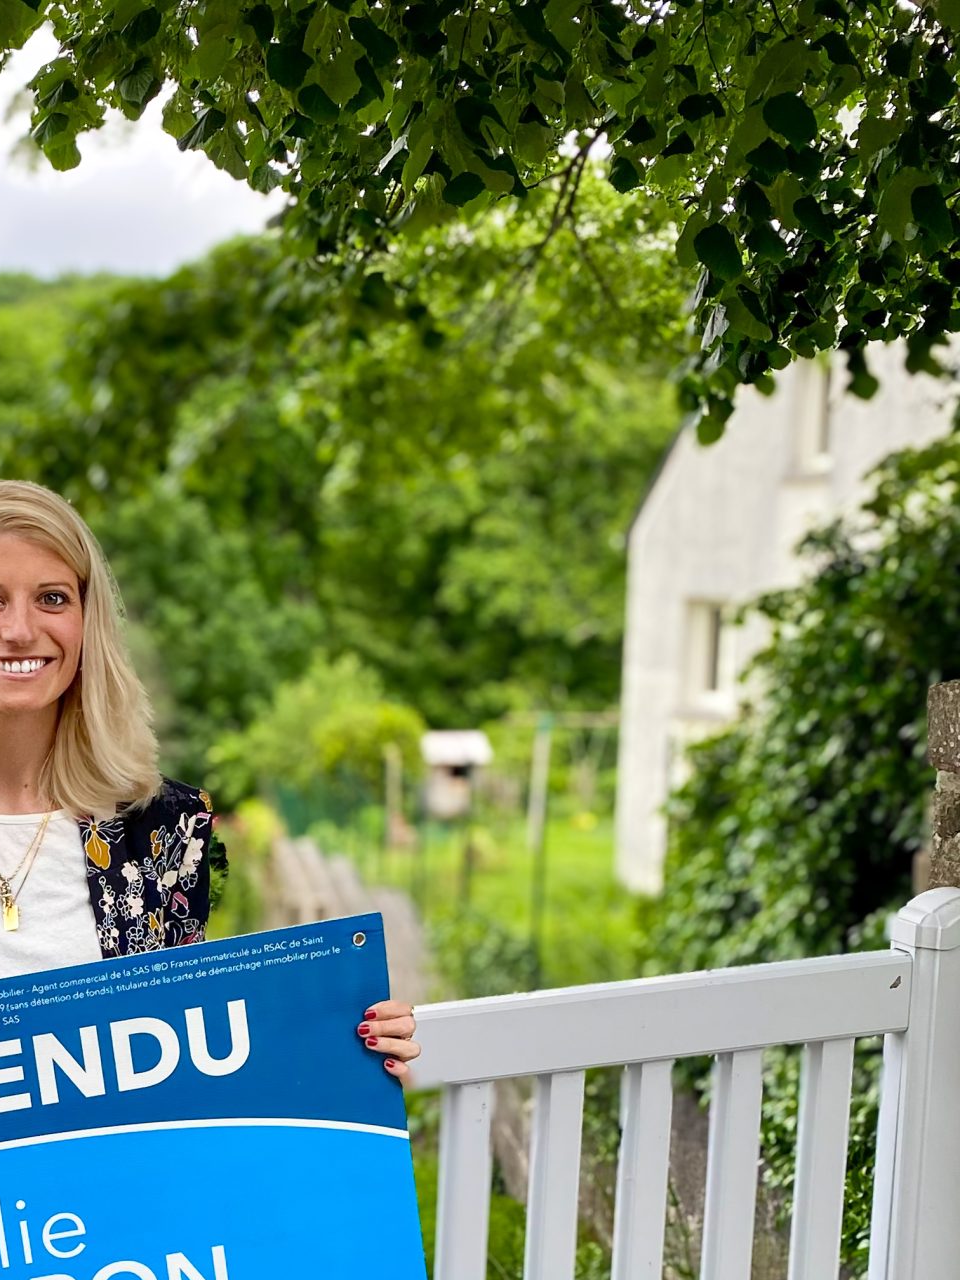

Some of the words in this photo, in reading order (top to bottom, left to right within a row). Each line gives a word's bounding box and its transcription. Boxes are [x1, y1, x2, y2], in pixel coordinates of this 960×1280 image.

[30, 994, 71, 1007] détention
[116, 980, 148, 992] titulaire
[172, 972, 194, 983] carte
[208, 960, 261, 976] démarchage
[263, 953, 308, 966] immobilier
[310, 950, 330, 960] pour
[32, 983, 57, 994] Agent
[60, 972, 108, 988] commercial
[132, 965, 149, 976] SAS
[151, 962, 168, 973] I@D
[170, 959, 198, 969] France
[200, 948, 249, 963] immatriculé
[264, 941, 287, 952] RSAC
[302, 936, 324, 946] Saint
[2, 1015, 20, 1026] SAS
